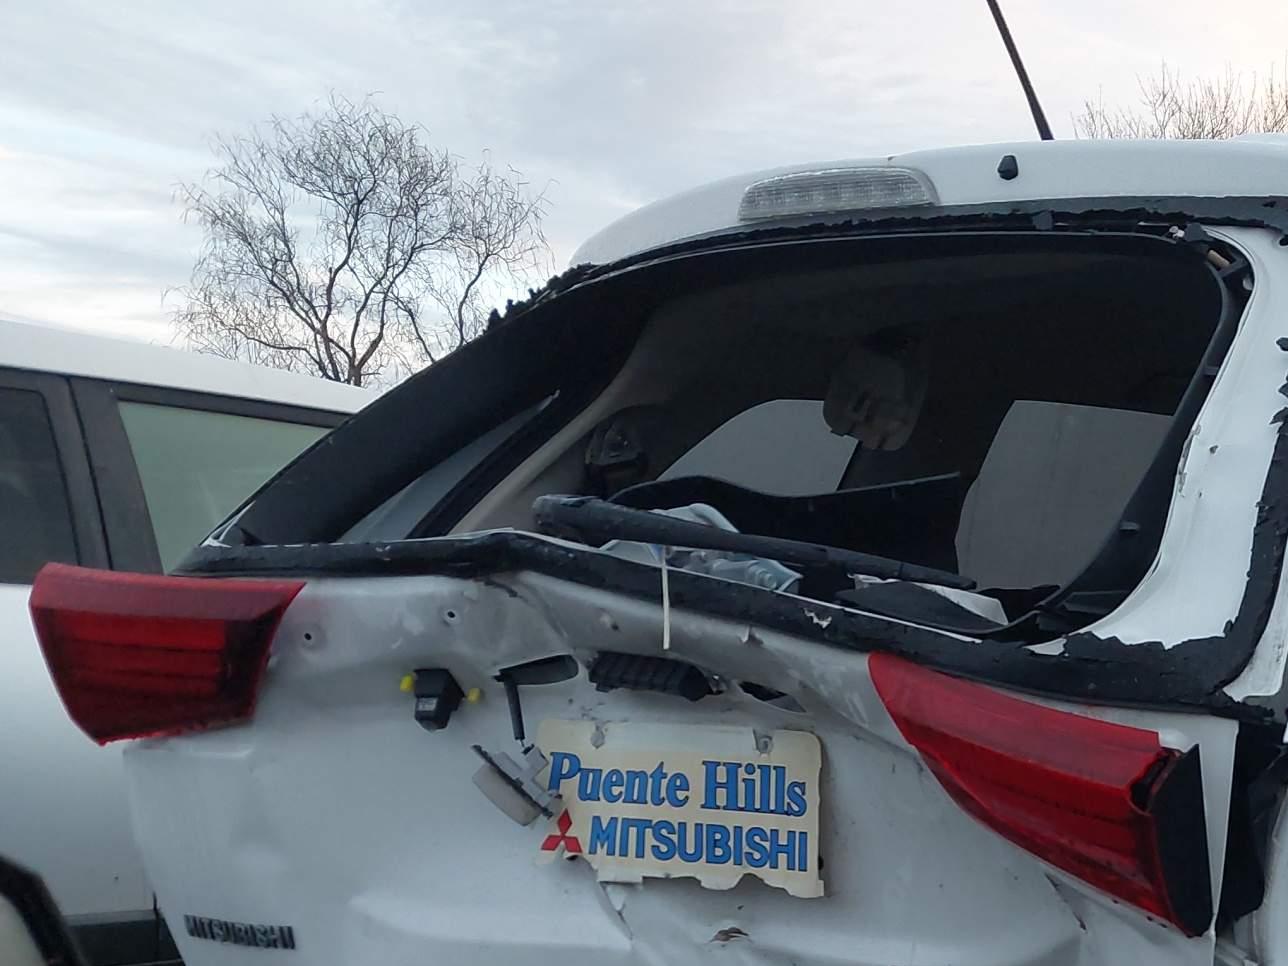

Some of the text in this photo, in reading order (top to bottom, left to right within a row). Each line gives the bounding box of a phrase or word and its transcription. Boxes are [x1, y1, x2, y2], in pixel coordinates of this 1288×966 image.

[548, 752, 807, 817] Puente Hills
[588, 815, 808, 872] MITSUBISHI
